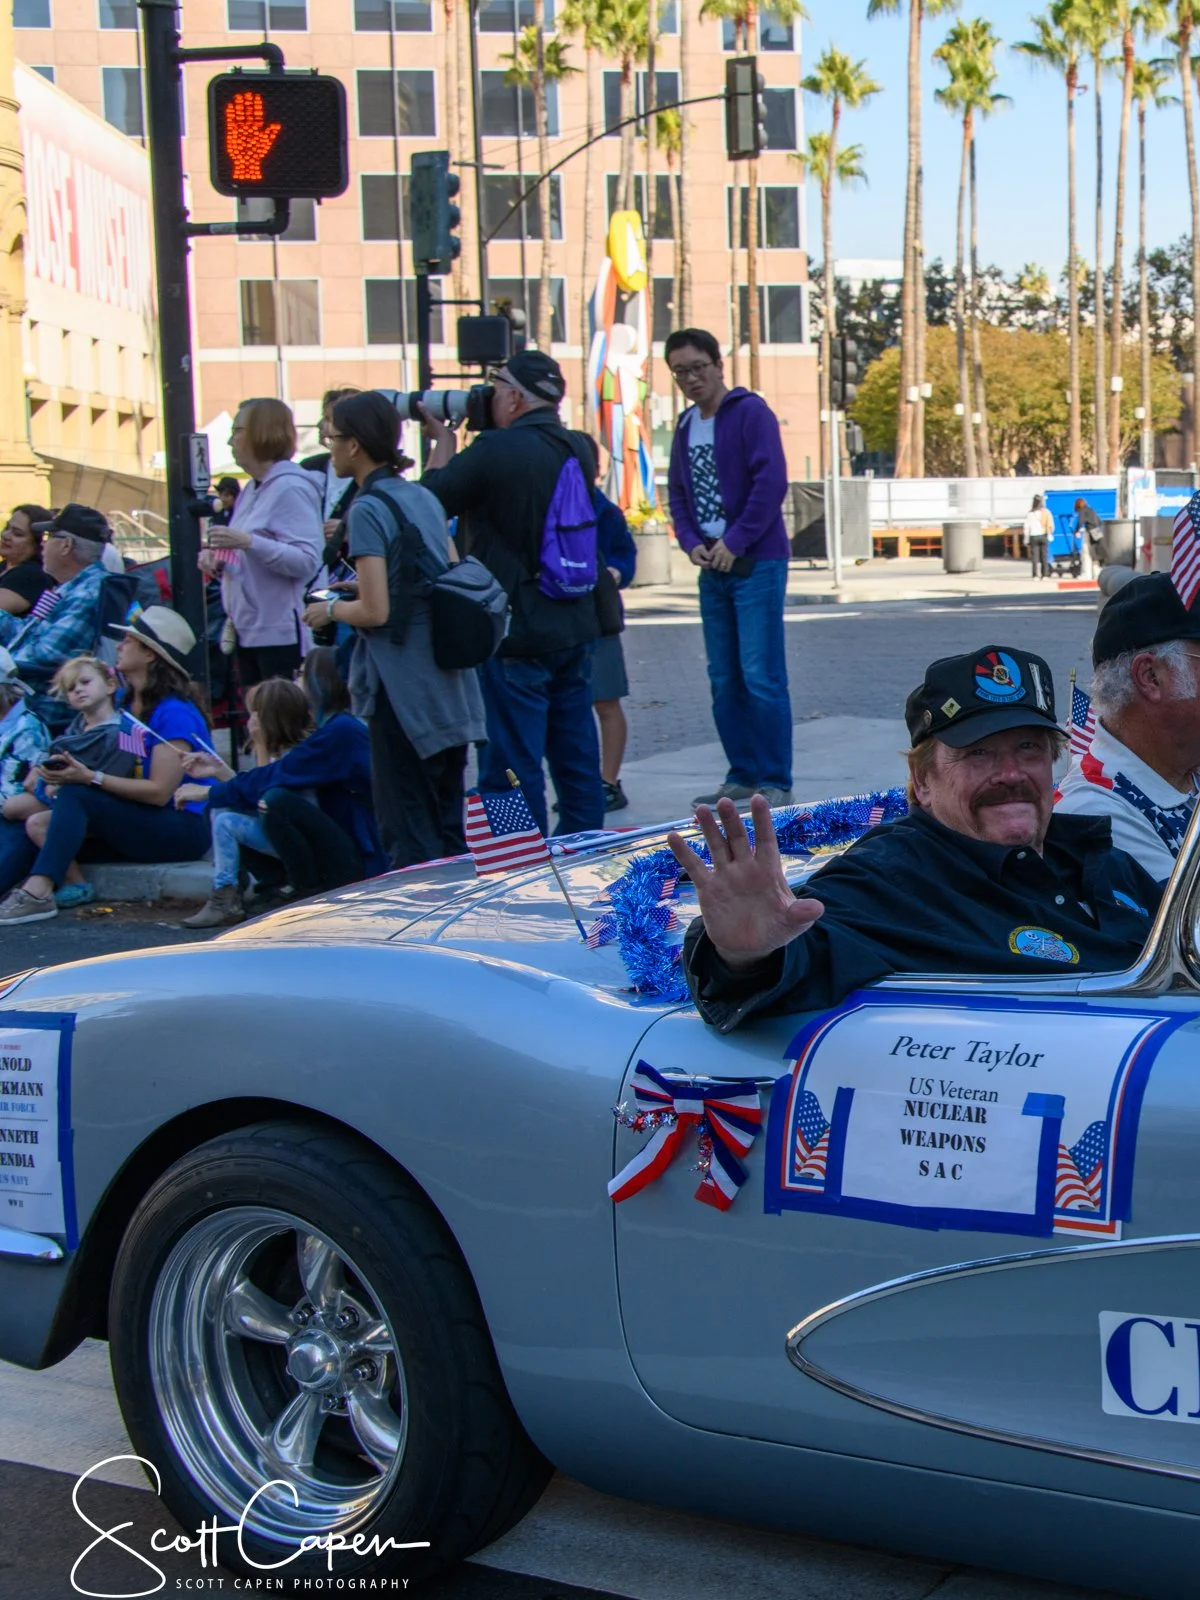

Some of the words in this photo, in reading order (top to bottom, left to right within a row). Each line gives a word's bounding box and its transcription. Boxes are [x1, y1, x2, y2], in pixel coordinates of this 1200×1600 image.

[888, 1035, 956, 1061] Peter
[964, 1040, 1045, 1073] Taylor
[0, 1080, 43, 1097] KMANN
[909, 1077, 935, 1096] US
[939, 1079, 999, 1103] Veteran
[903, 1099, 988, 1125] NUCLEAR
[900, 1128, 987, 1154] WEAPONS
